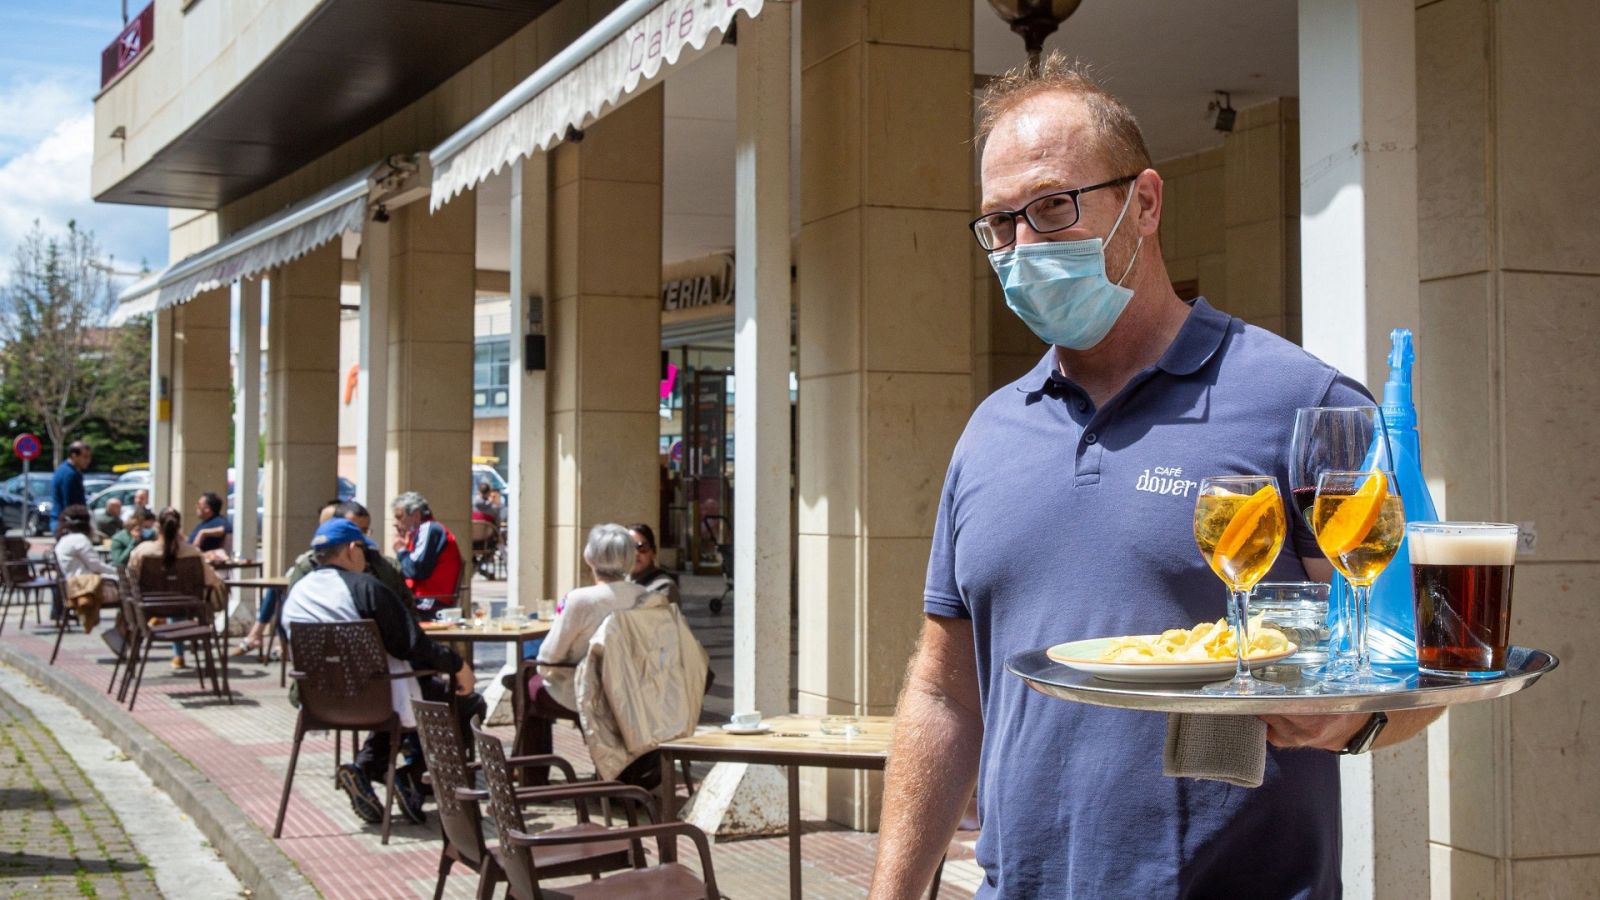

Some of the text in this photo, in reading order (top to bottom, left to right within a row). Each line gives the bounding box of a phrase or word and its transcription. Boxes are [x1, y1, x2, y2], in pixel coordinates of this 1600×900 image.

[630, 3, 694, 72] Café
[1135, 469, 1197, 498] dover
[1154, 465, 1183, 477] CAFÉ
